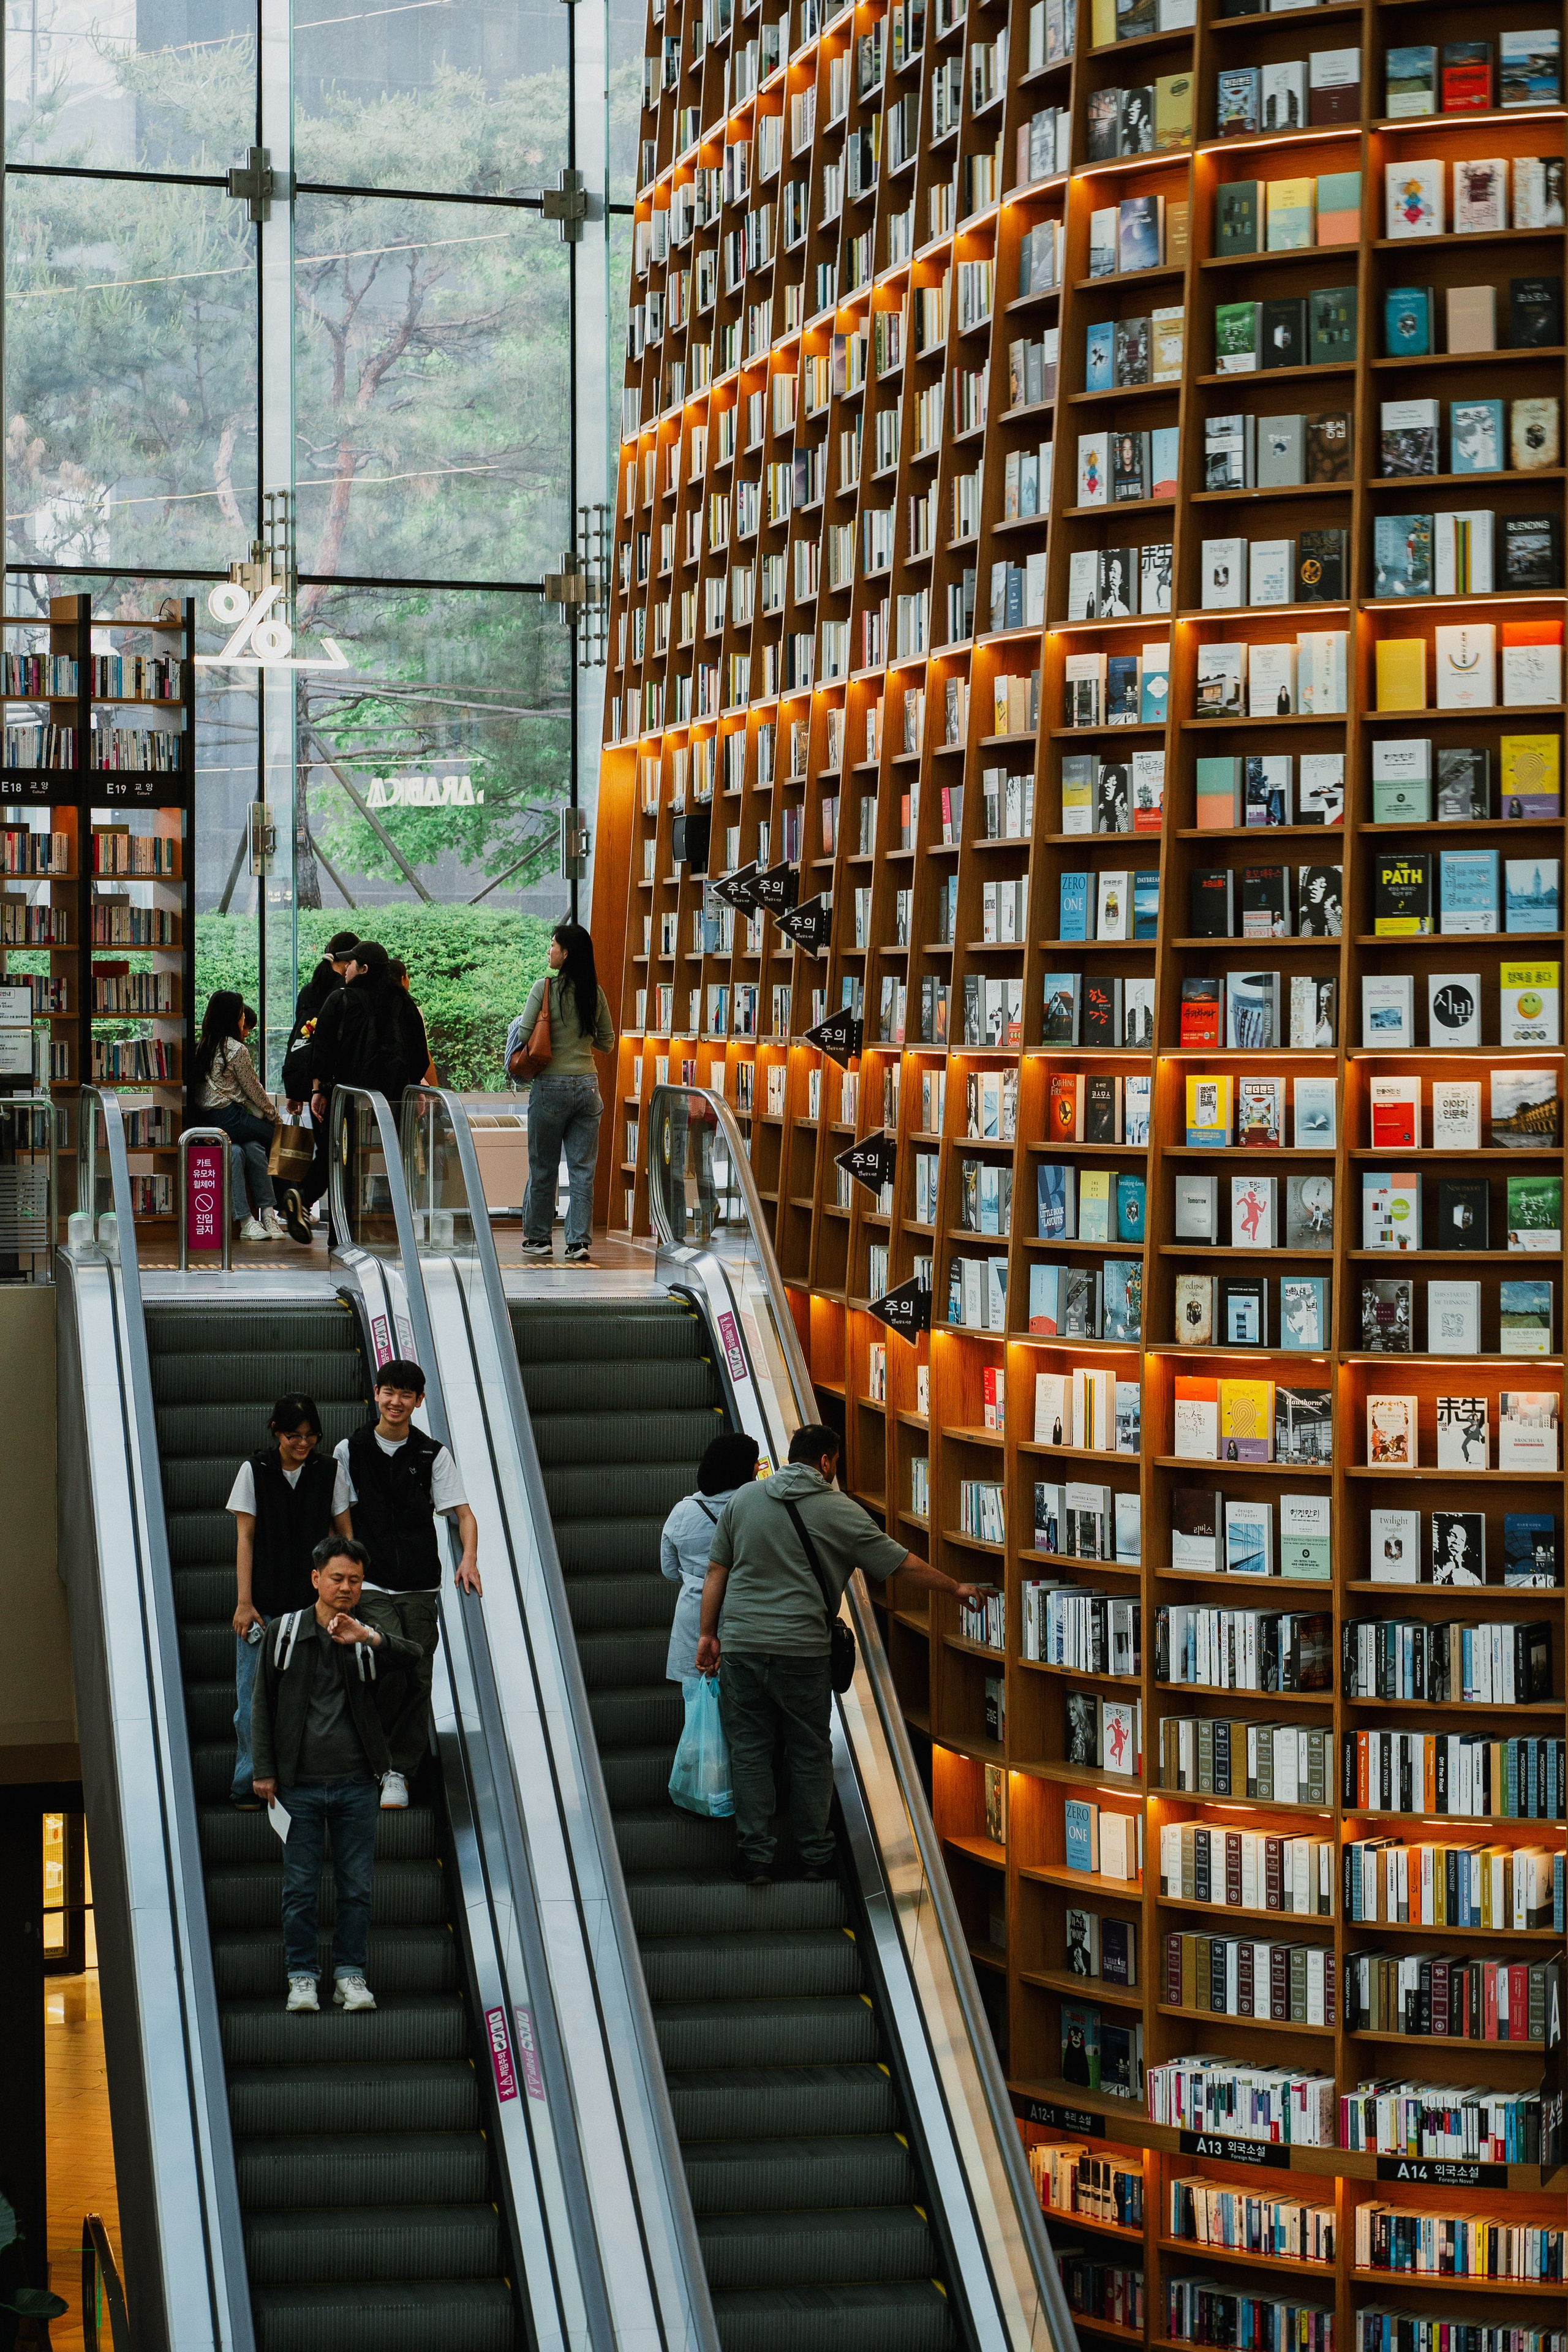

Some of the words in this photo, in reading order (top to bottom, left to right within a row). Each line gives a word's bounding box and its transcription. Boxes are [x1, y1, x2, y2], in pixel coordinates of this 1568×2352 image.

[1506, 521, 1550, 531] BLENDING
[1, 781, 21, 793] E18
[107, 783, 127, 794] E19
[1062, 876, 1086, 889] ZERO
[1382, 869, 1422, 884] PATH
[758, 880, 783, 895] 주의
[1063, 897, 1083, 910] ONE
[790, 916, 816, 931] 주의
[1244, 927, 1266, 938] Homo
[1267, 927, 1285, 937] Deus
[1434, 989, 1474, 1025] 시밤
[820, 1028, 846, 1043] 주의
[1443, 1100, 1468, 1109] 이야기
[1443, 1110, 1468, 1119] 인문학
[851, 1153, 879, 1169] 주의
[193, 1169, 215, 1178] 유모차
[196, 1214, 213, 1224] 진입
[1040, 1208, 1053, 1218] LITTLE
[195, 1225, 213, 1235] 금지
[1185, 1280, 1204, 1290] eclipse
[884, 1300, 913, 1316] 주의
[1306, 1302, 1317, 1311] 논리
[1290, 1509, 1320, 1518] 명견만리
[1379, 1515, 1409, 1527] twilight
[1194, 1524, 1213, 1535] 리버스
[1066, 1804, 1089, 1822] ZERO
[1069, 1825, 1087, 1842] ONE
[1411, 1885, 1418, 1893] 75
[1113, 1965, 1126, 1973] CITIES
[1030, 2103, 1055, 2122] A12-1
[1064, 2112, 1077, 2122] 추리
[1079, 2115, 1091, 2126] 소설
[1196, 2138, 1221, 2155] A13
[1227, 2141, 1266, 2157] 외국소설
[1397, 2162, 1428, 2179] A14
[1434, 2164, 1479, 2178] 외국소설
